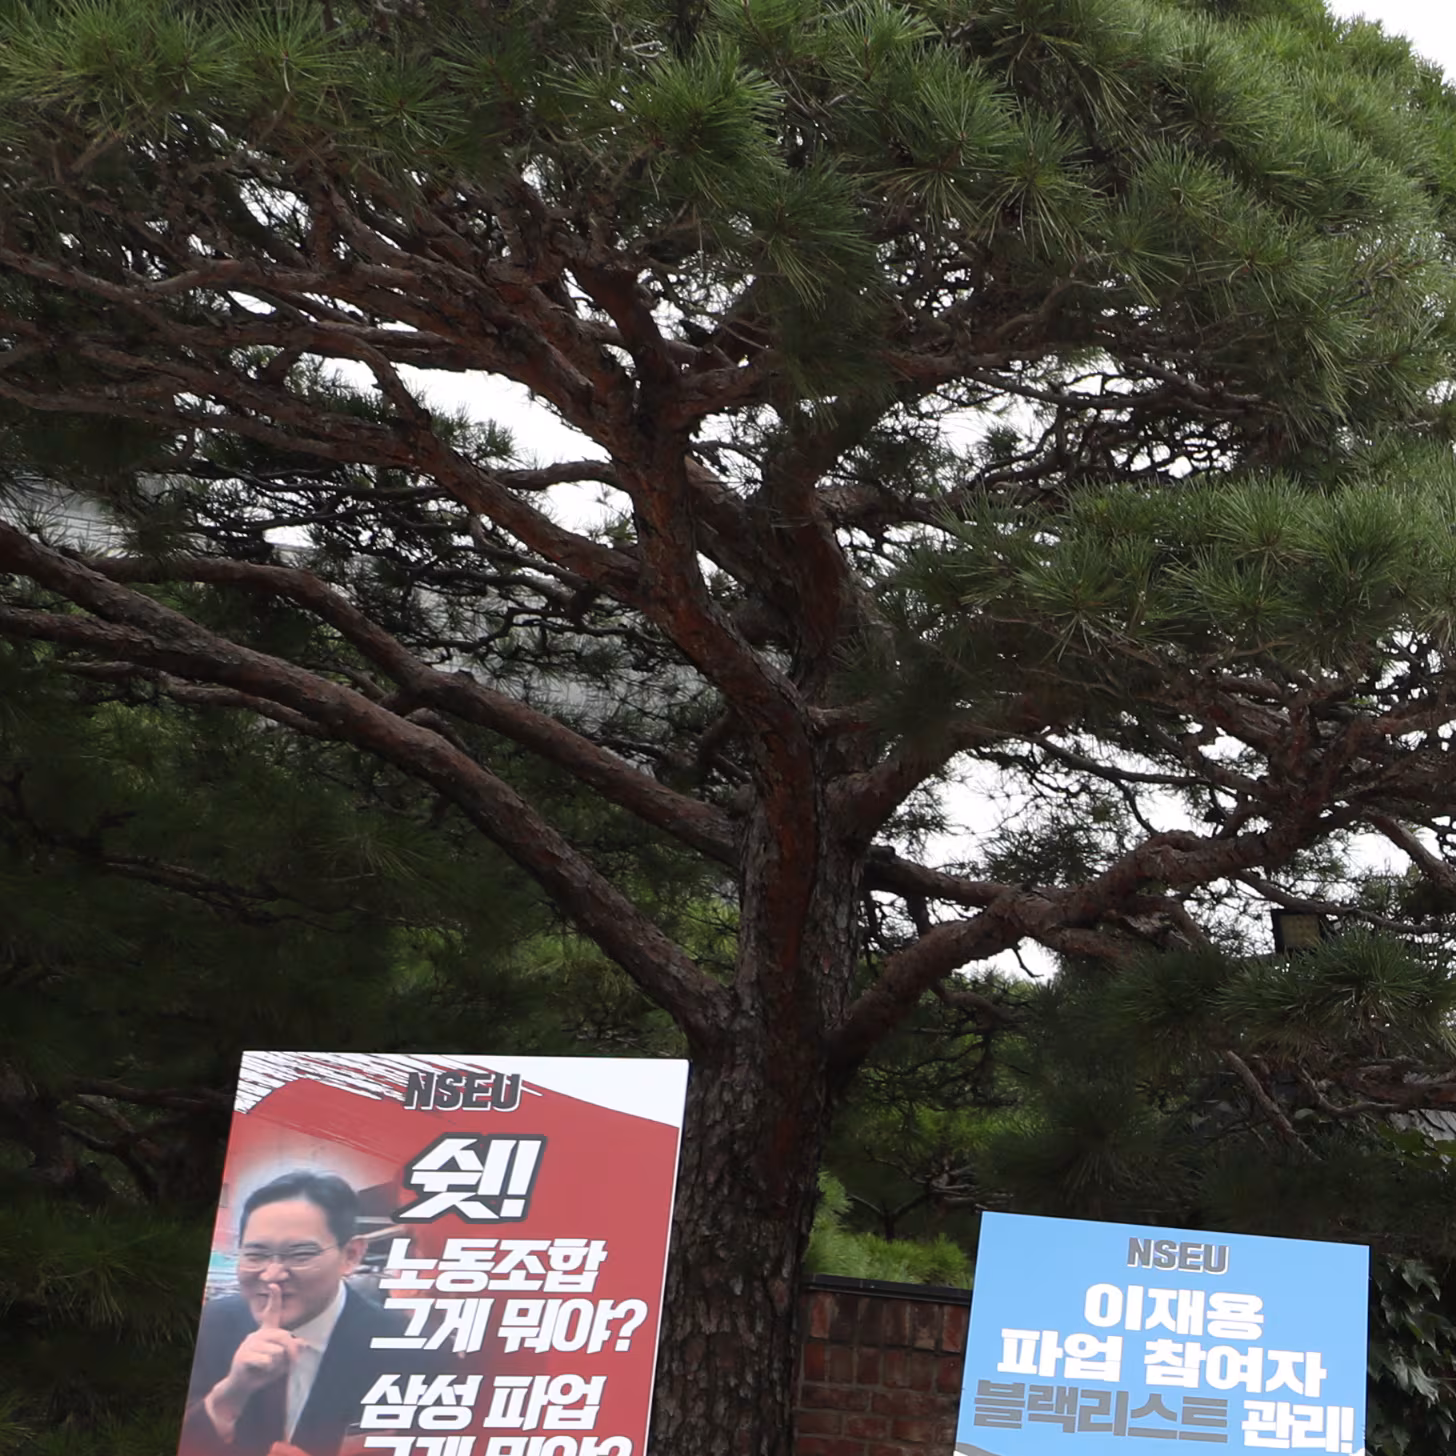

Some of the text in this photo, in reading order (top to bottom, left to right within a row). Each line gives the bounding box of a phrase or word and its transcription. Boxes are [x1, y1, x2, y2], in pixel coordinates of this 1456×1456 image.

[403, 1072, 521, 1112] NSEU
[396, 1134, 546, 1221] 쉿!
[379, 1237, 608, 1293] 노동조합
[1127, 1237, 1230, 1275] NSEU
[370, 1298, 647, 1354] 그게 뭐야?
[1084, 1283, 1265, 1341] 이재용
[997, 1328, 1326, 1398] 파업 참여자
[359, 1374, 607, 1431] 삼성 파업
[973, 1379, 1354, 1454] 블랙리스트 관리!
